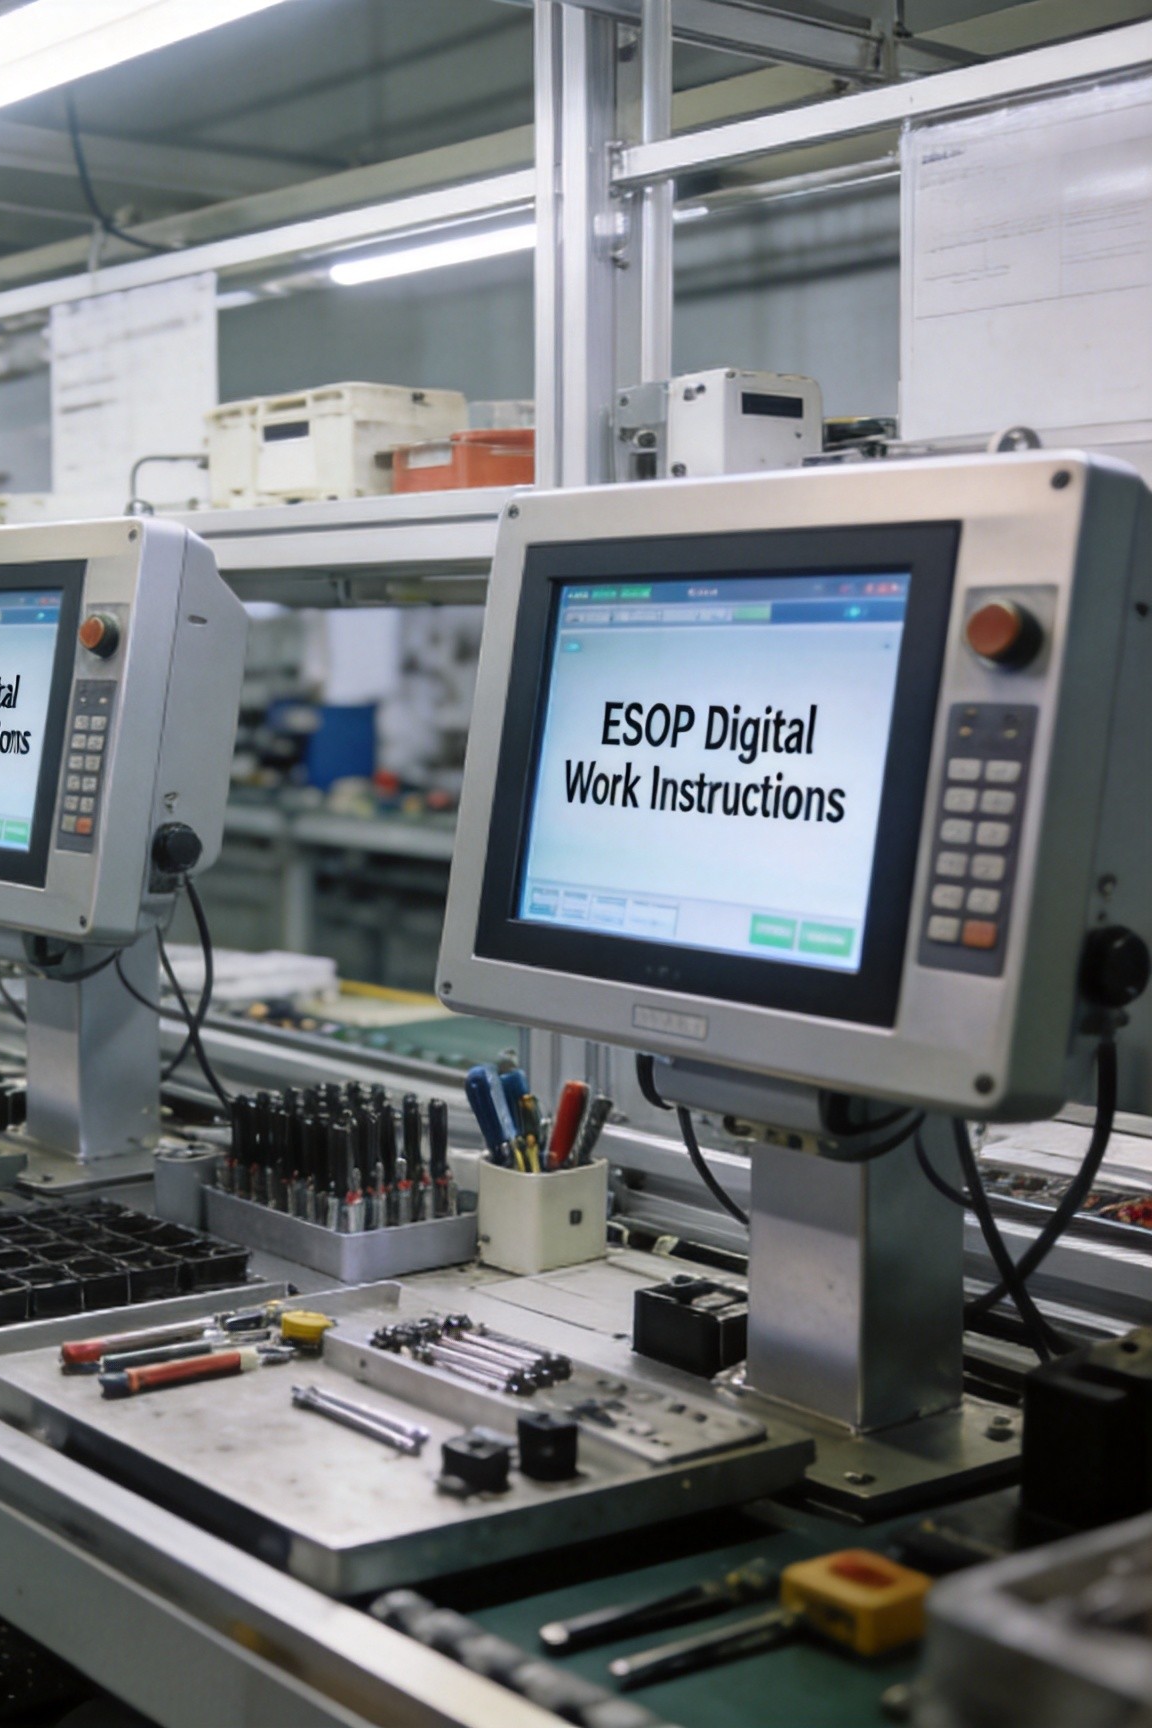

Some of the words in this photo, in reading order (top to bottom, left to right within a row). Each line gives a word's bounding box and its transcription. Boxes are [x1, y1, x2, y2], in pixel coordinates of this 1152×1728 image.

[600, 701, 696, 748] ESOP
[703, 703, 818, 765] Digital
[564, 759, 641, 809] Work
[650, 765, 846, 824] Instructions
